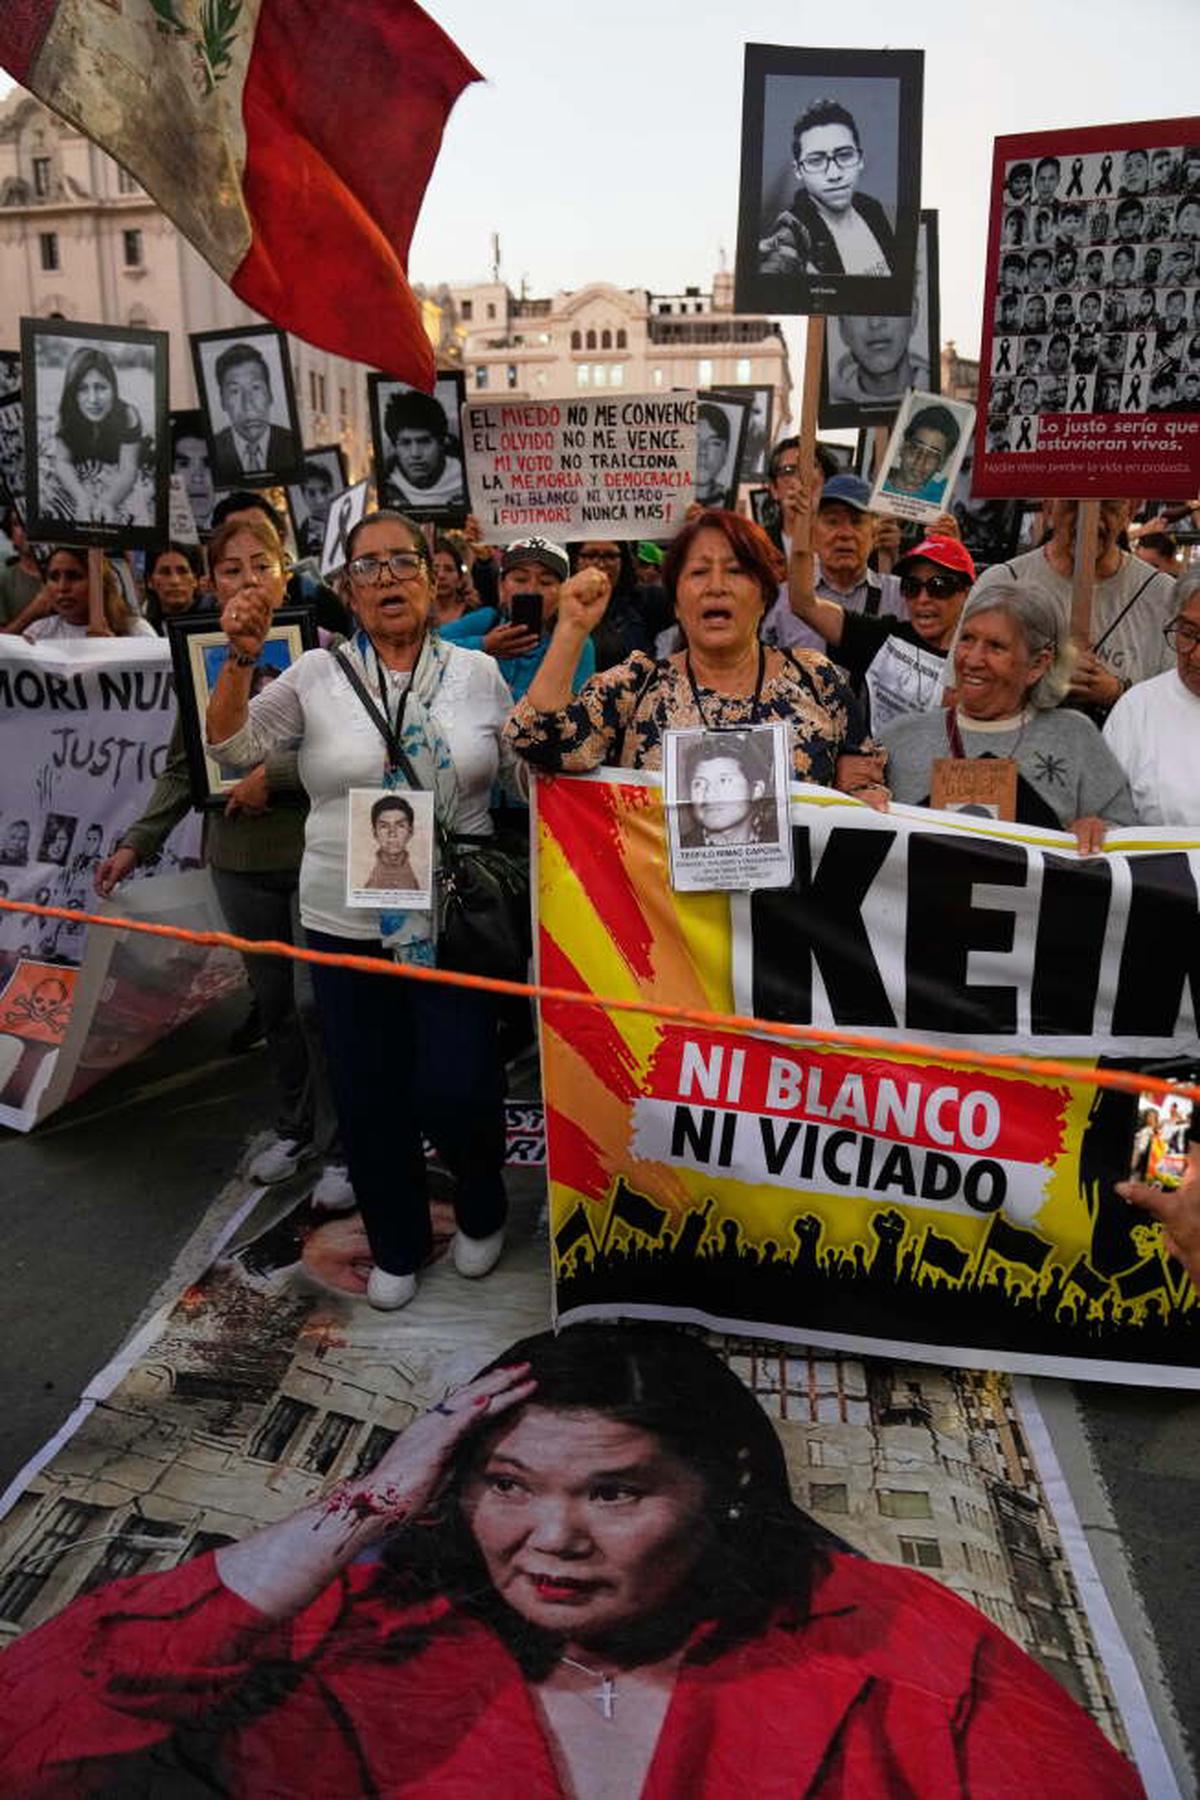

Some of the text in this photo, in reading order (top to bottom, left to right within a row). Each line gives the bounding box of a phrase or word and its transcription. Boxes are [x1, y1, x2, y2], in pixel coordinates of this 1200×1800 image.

[470, 401, 697, 429] EL MIEDO NO ME CONVENCE
[1039, 416, 1200, 438] Lo justo sería que
[473, 429, 686, 452] EL OLVIDO NO ME VENCE.
[1036, 435, 1183, 451] estuvieran vivas.
[494, 453, 678, 472] MI VOTO NO TRAICIONA
[482, 471, 692, 490] LA MEMORIA Y DEMOCRACIA
[504, 489, 663, 507] NI BLANCO NI VICIADO
[581, 504, 628, 522] NUNCA
[677, 1041, 1001, 1151] NI BLANCO
[671, 1105, 1008, 1214] NI VICIADO
